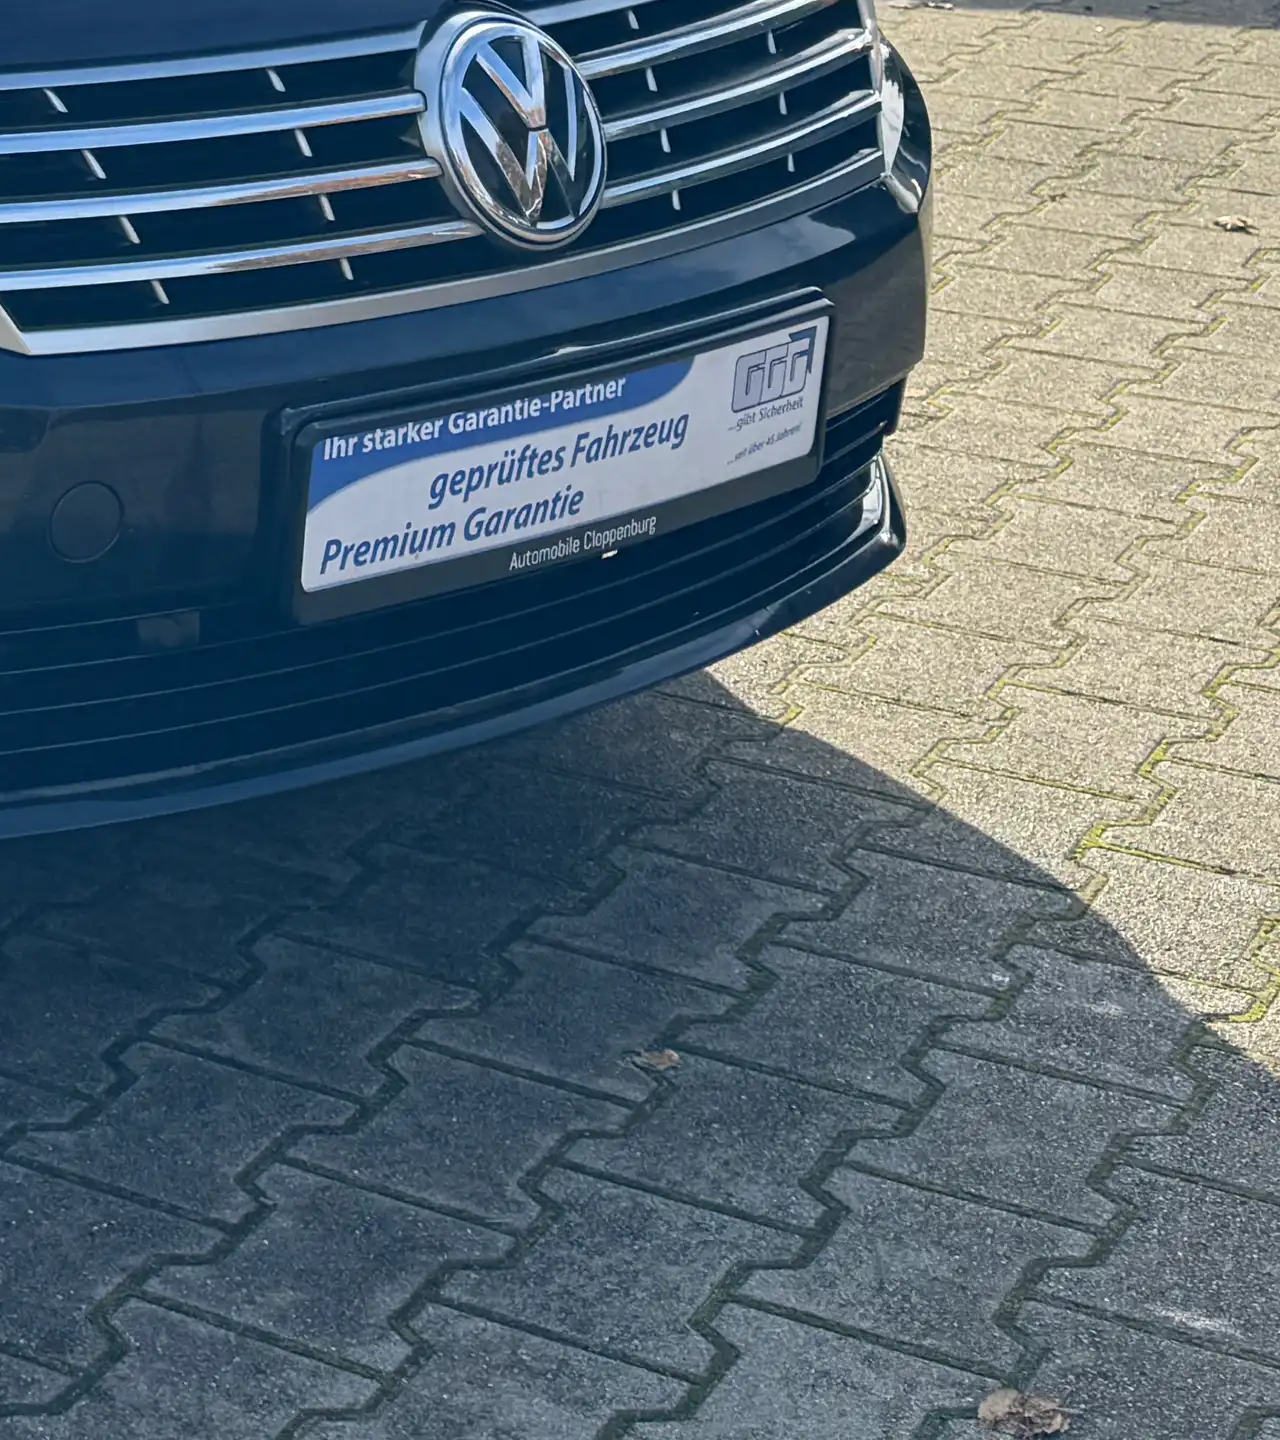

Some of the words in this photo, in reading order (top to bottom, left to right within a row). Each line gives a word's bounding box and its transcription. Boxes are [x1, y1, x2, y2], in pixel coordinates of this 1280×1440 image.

[324, 437, 358, 460] Ihr
[362, 419, 444, 453] starker
[448, 377, 627, 435] Garantie-Partner
[428, 443, 566, 510] geprüftes
[570, 413, 690, 468] Fahrzeug
[320, 520, 456, 575] Premium
[463, 484, 584, 541] Garantie
[509, 537, 580, 570] Automobile
[584, 516, 657, 550] Cloppenburg
